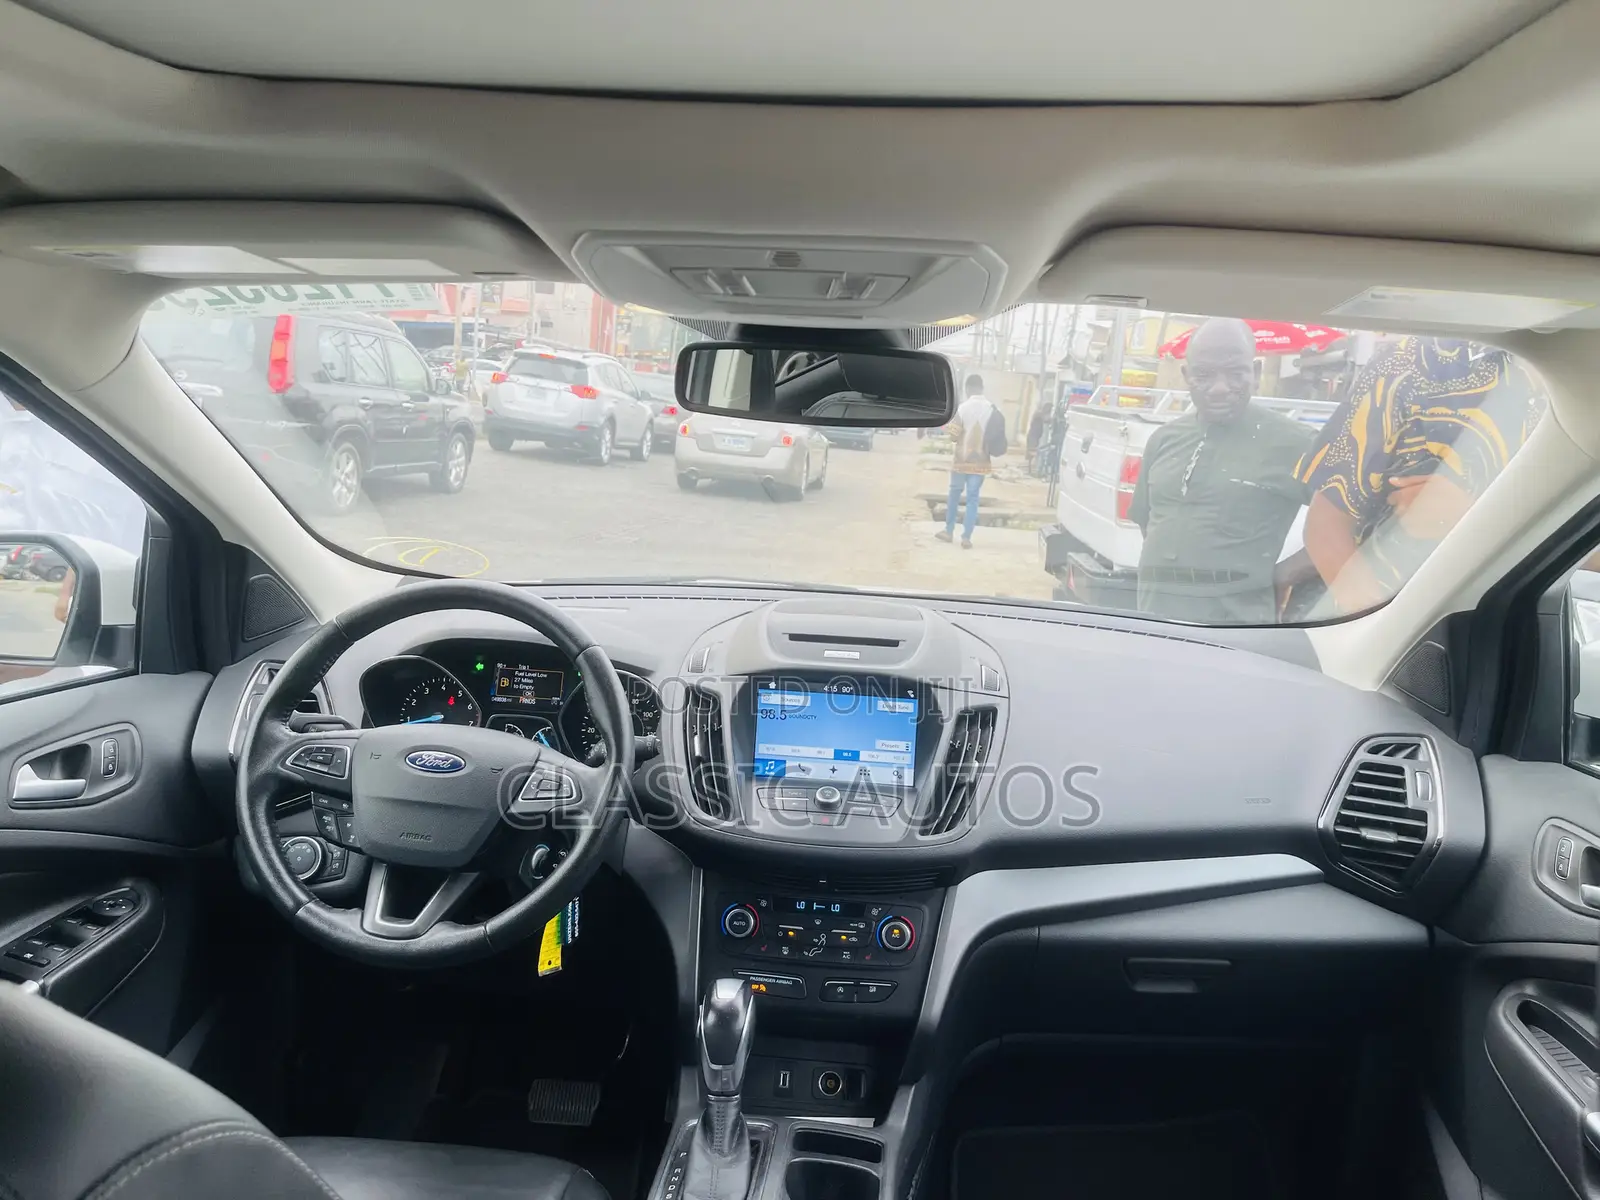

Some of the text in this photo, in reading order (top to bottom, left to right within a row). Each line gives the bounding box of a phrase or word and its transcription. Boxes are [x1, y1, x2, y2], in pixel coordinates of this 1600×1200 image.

[424, 687, 430, 695] 3
[823, 685, 838, 693] 4:15
[760, 708, 788, 721] 98.5
[415, 753, 453, 769] Ford
[399, 832, 432, 842] AIRBAG
[796, 901, 806, 909] LO
[830, 904, 841, 912] LO
